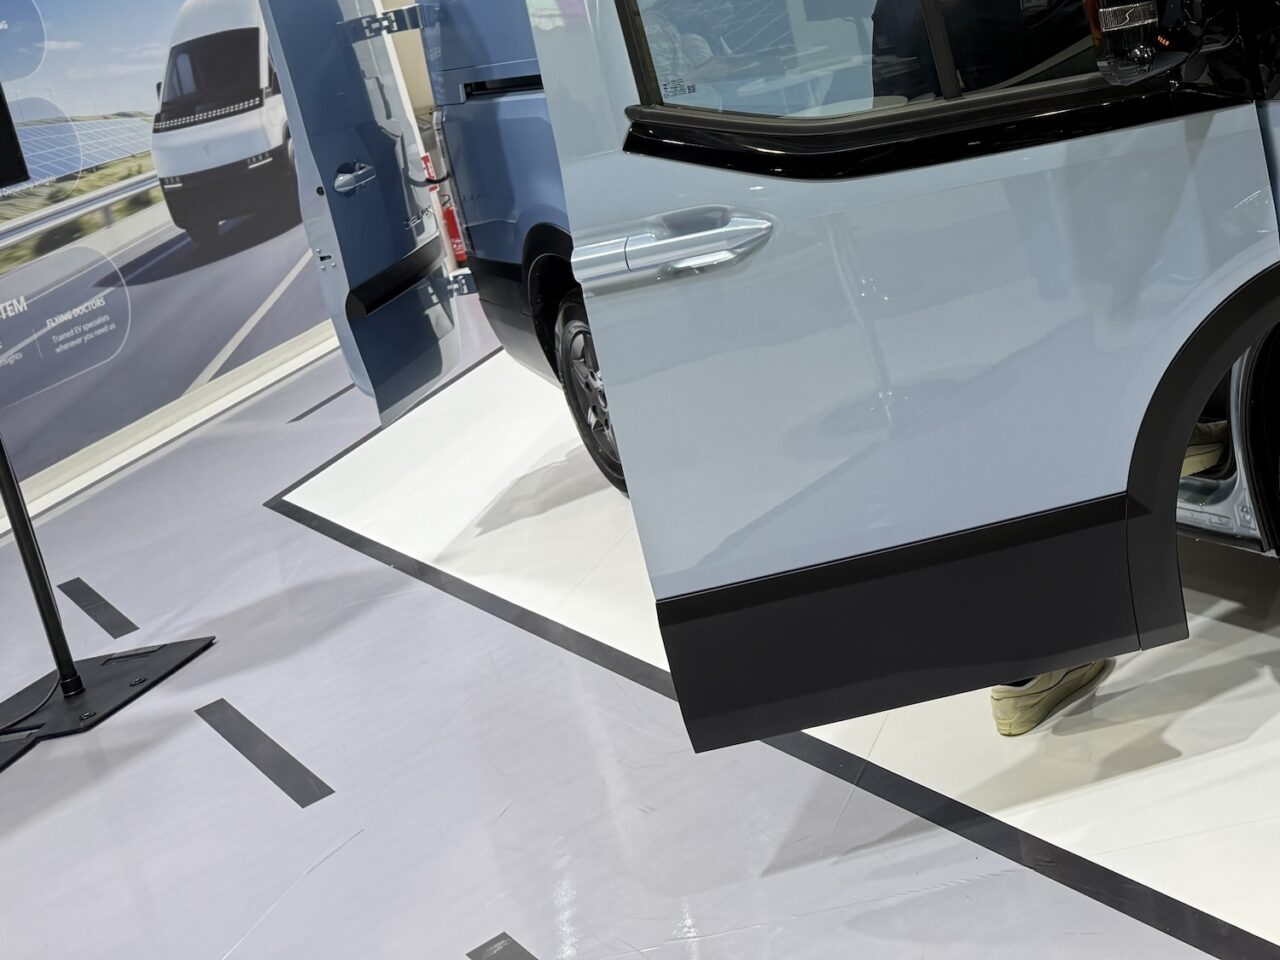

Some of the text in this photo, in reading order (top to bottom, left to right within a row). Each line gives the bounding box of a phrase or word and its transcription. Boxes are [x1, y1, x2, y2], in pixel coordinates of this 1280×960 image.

[46, 296, 106, 329] FLYING DOCTORS
[74, 325, 83, 334] EV
[83, 332, 95, 343] you
[94, 326, 109, 336] need
